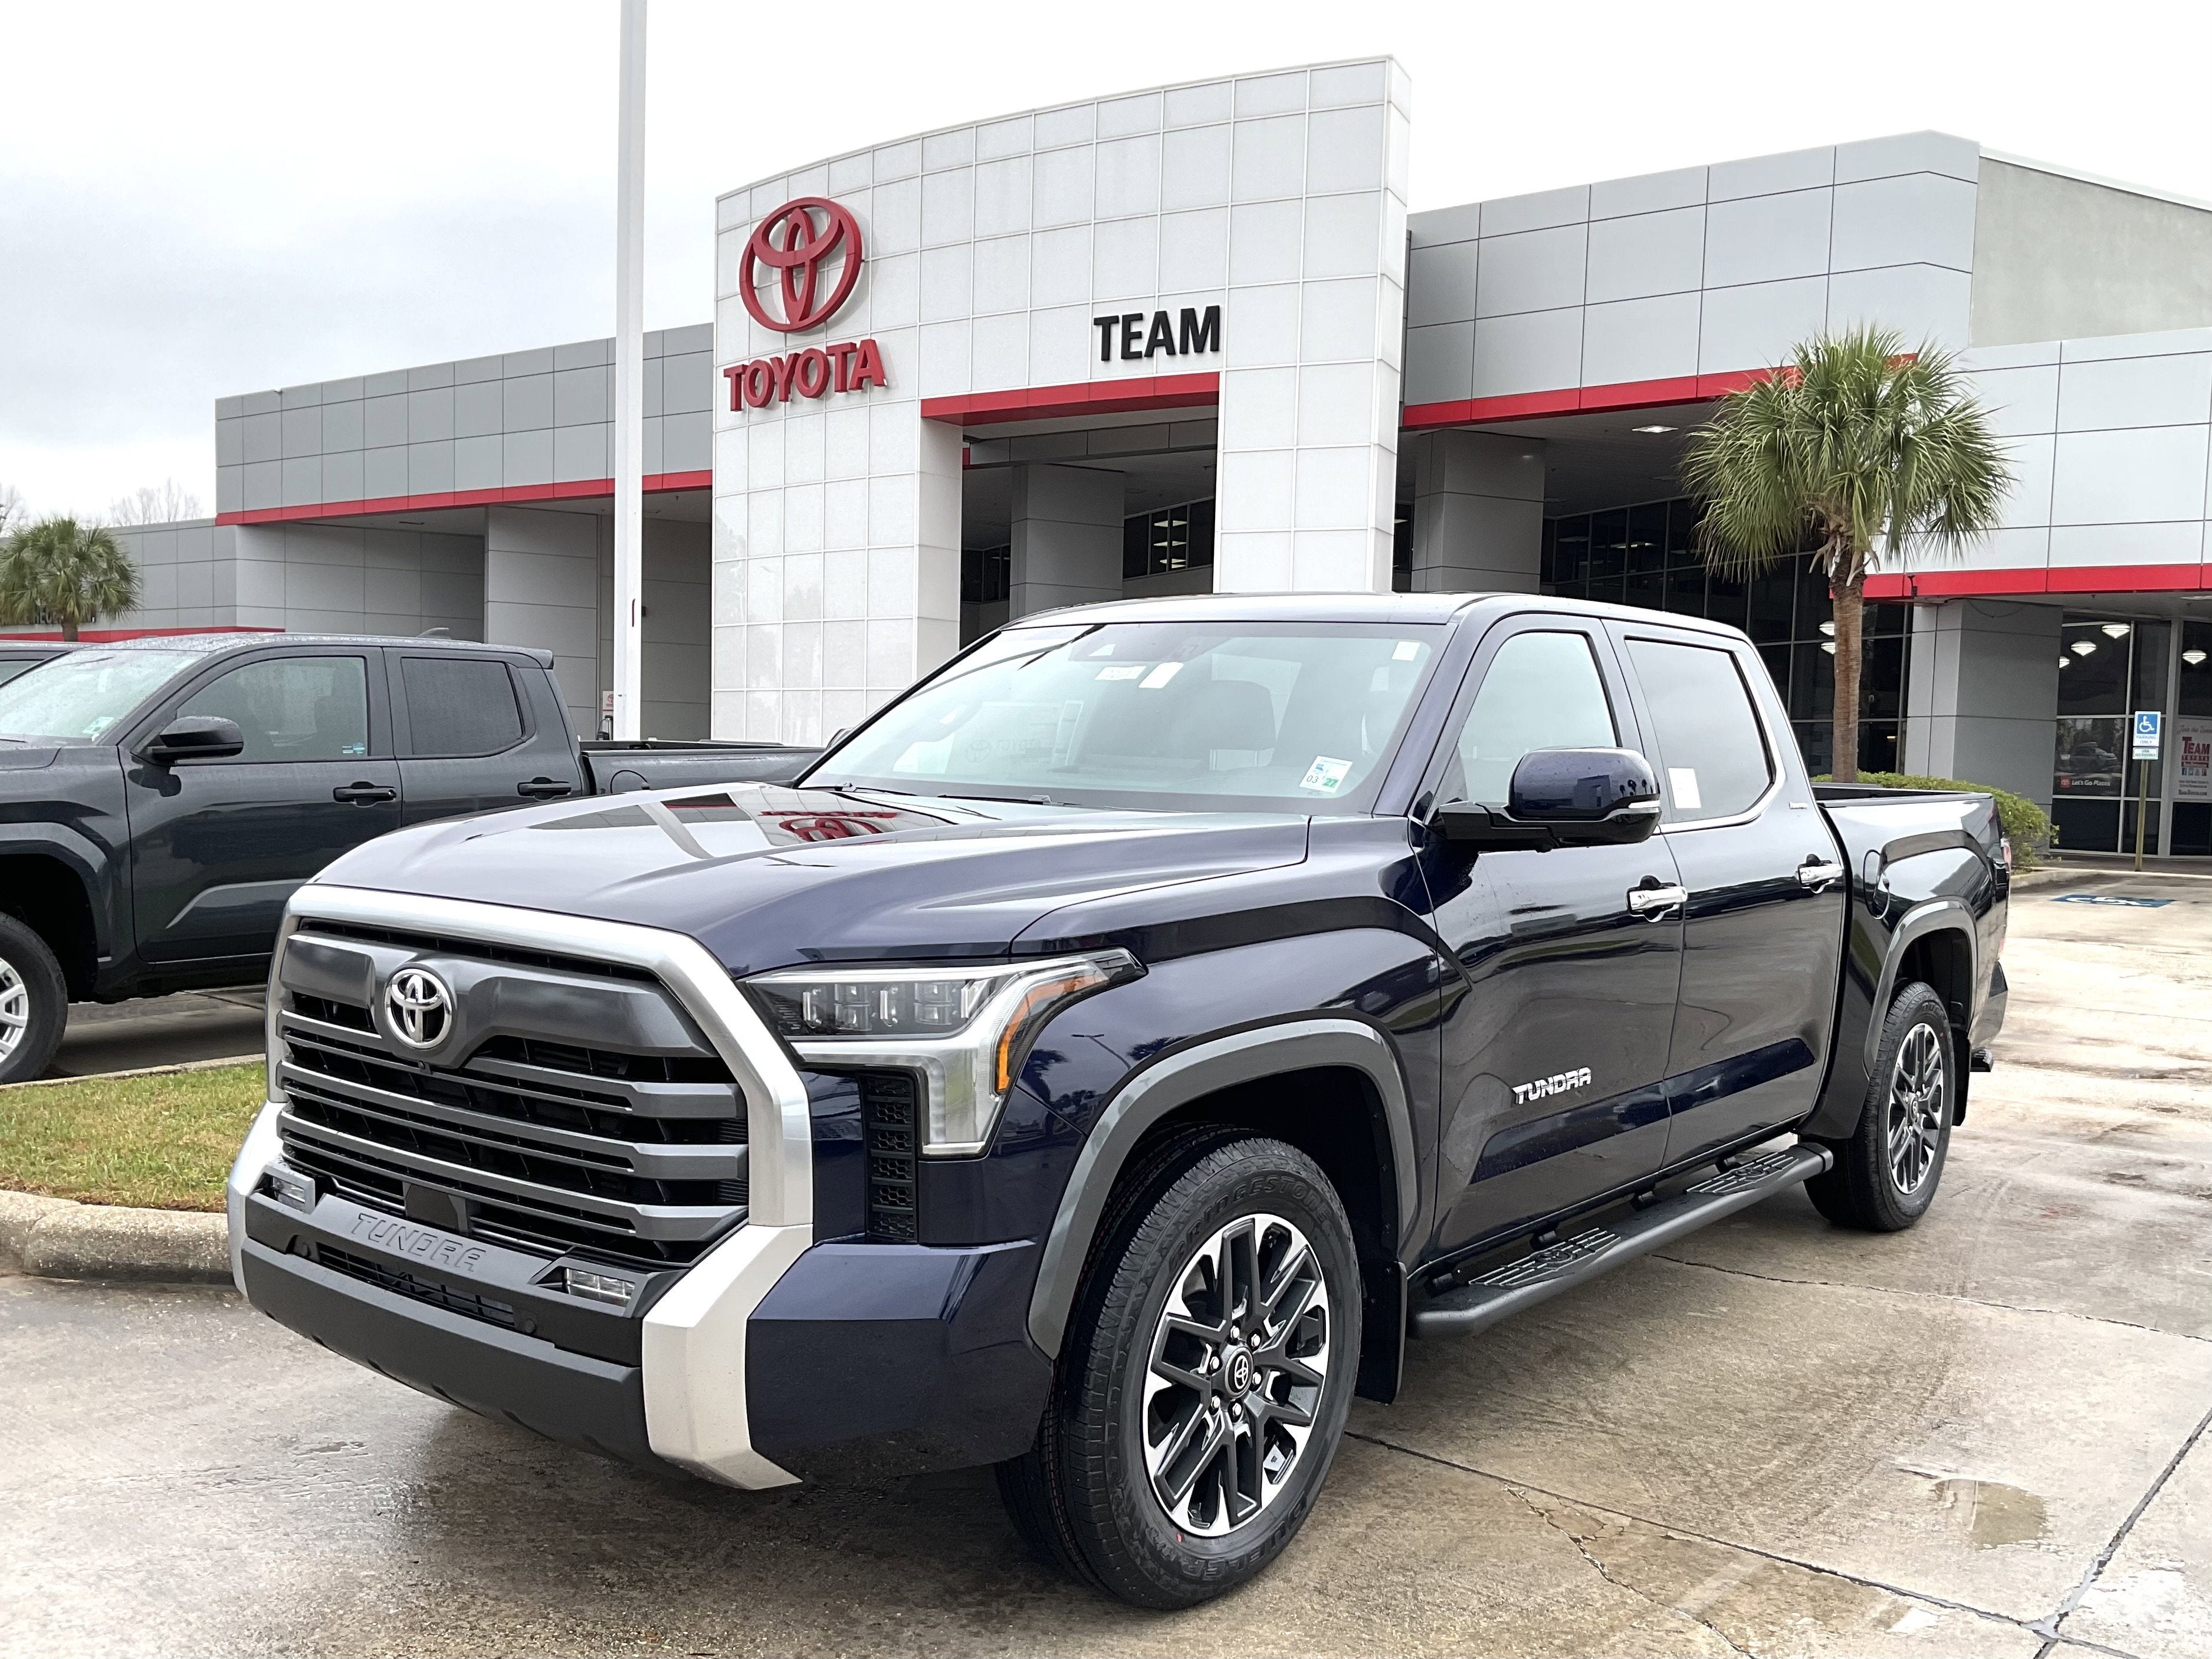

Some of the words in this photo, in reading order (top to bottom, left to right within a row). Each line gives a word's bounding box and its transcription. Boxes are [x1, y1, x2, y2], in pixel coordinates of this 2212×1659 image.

[1093, 304, 1220, 362] TEAM
[723, 339, 888, 412] TOYOTA
[2183, 736, 2210, 754] TEAM
[1306, 775, 1319, 783] 03
[1323, 778, 1338, 787] 27
[1511, 1067, 1592, 1105] TUNDRA
[351, 1212, 487, 1272] TUNDRA
[1169, 1175, 1331, 1270] BRIDGESTONE
